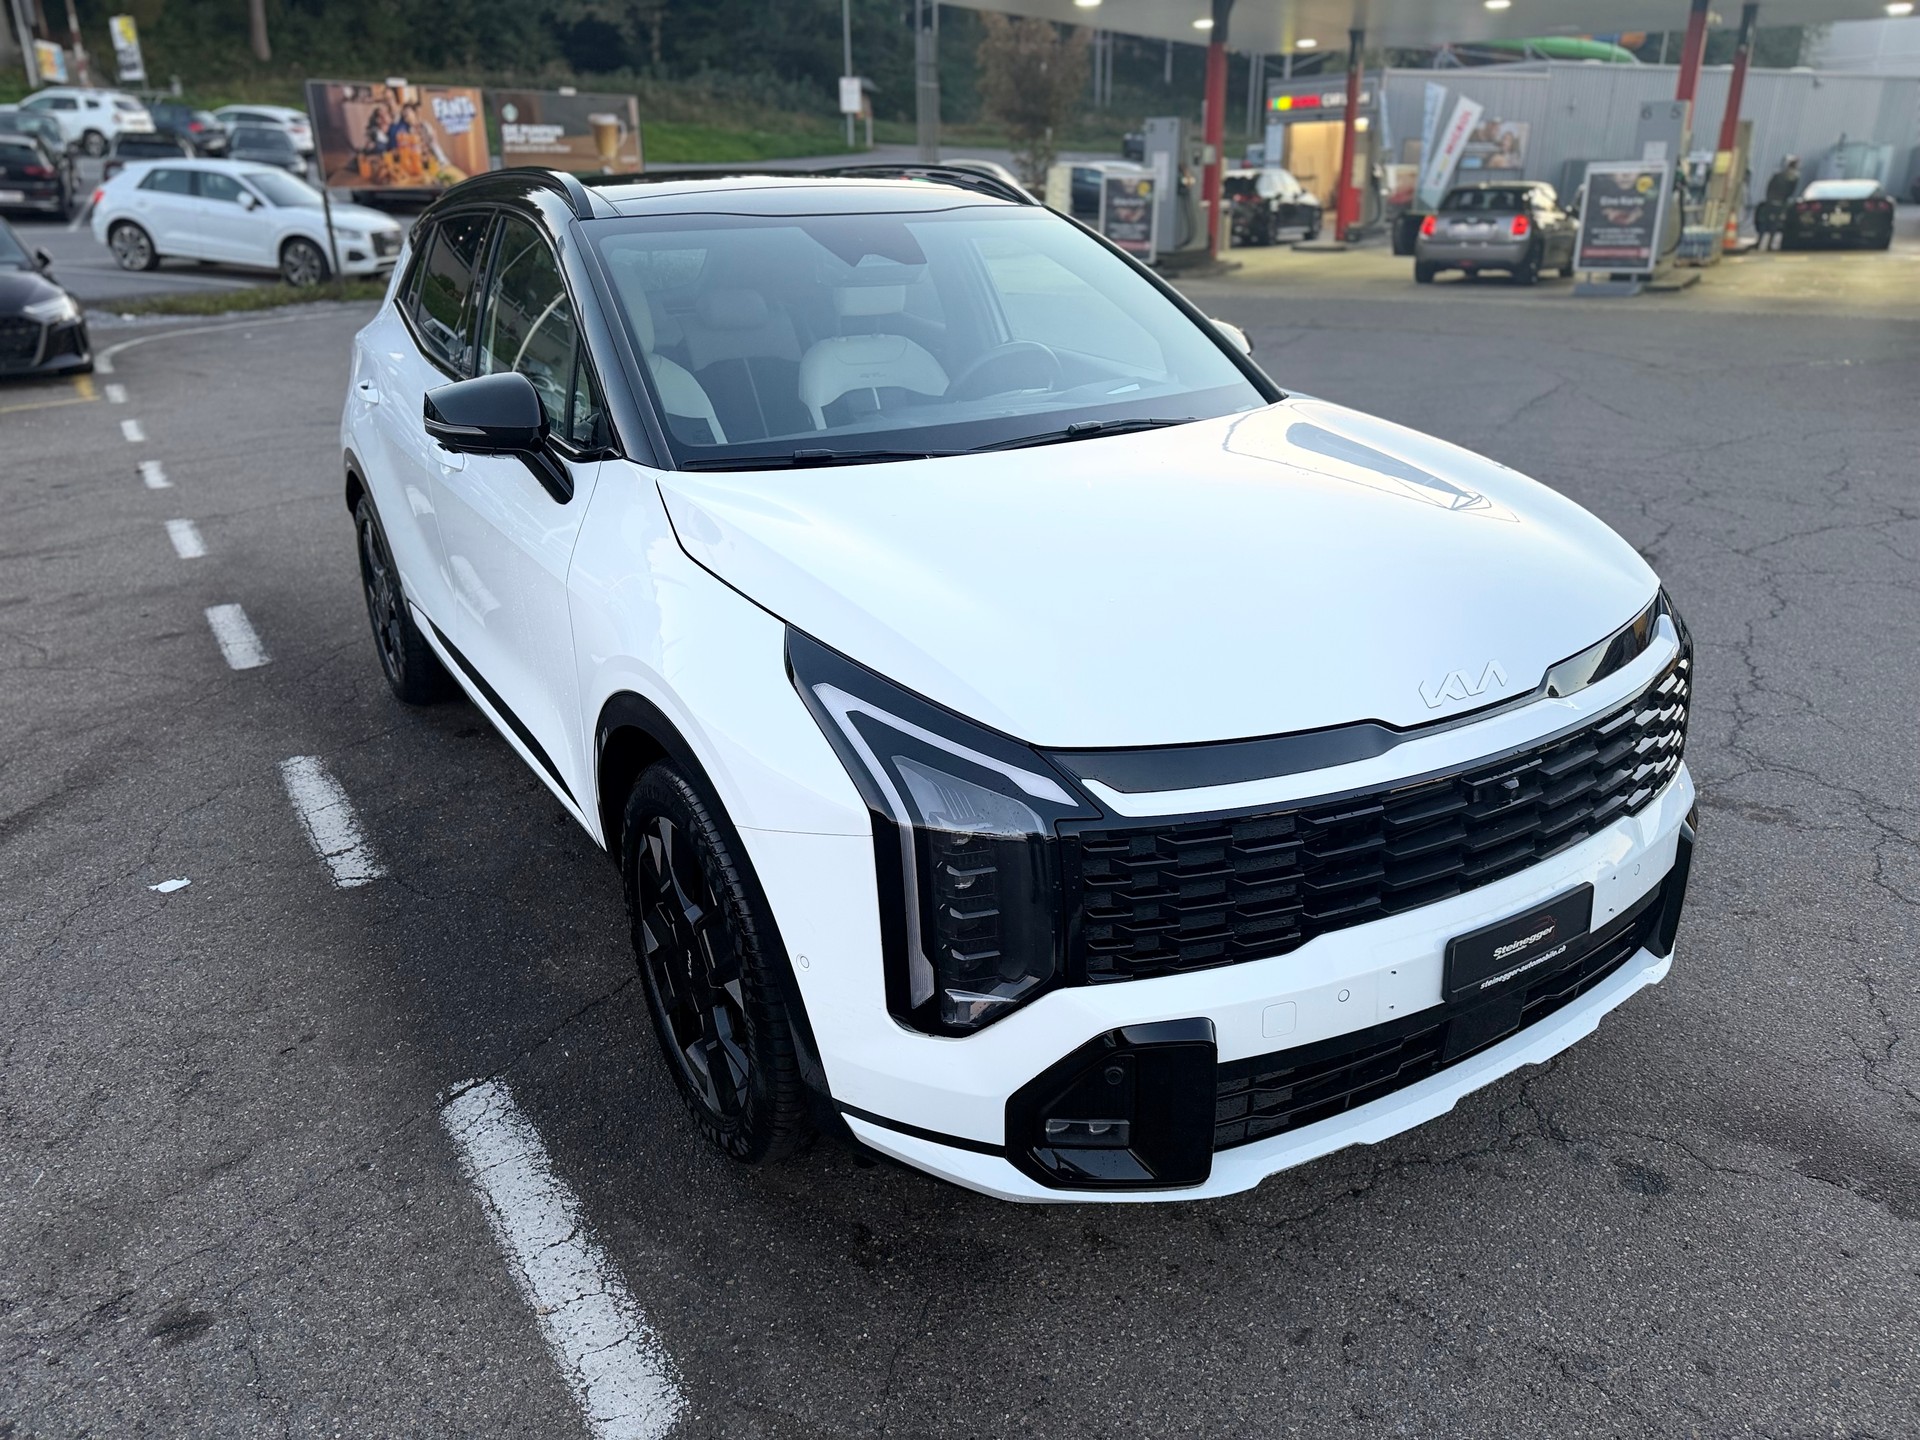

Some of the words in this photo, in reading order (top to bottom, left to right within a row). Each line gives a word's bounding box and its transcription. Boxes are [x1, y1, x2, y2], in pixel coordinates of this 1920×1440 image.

[1641, 105, 1653, 120] 6
[1669, 104, 1681, 120] 5
[1418, 659, 1508, 709] KIA
[1493, 925, 1555, 957] Steinegger
[1480, 945, 1566, 989] steinegger-automobile.ch
